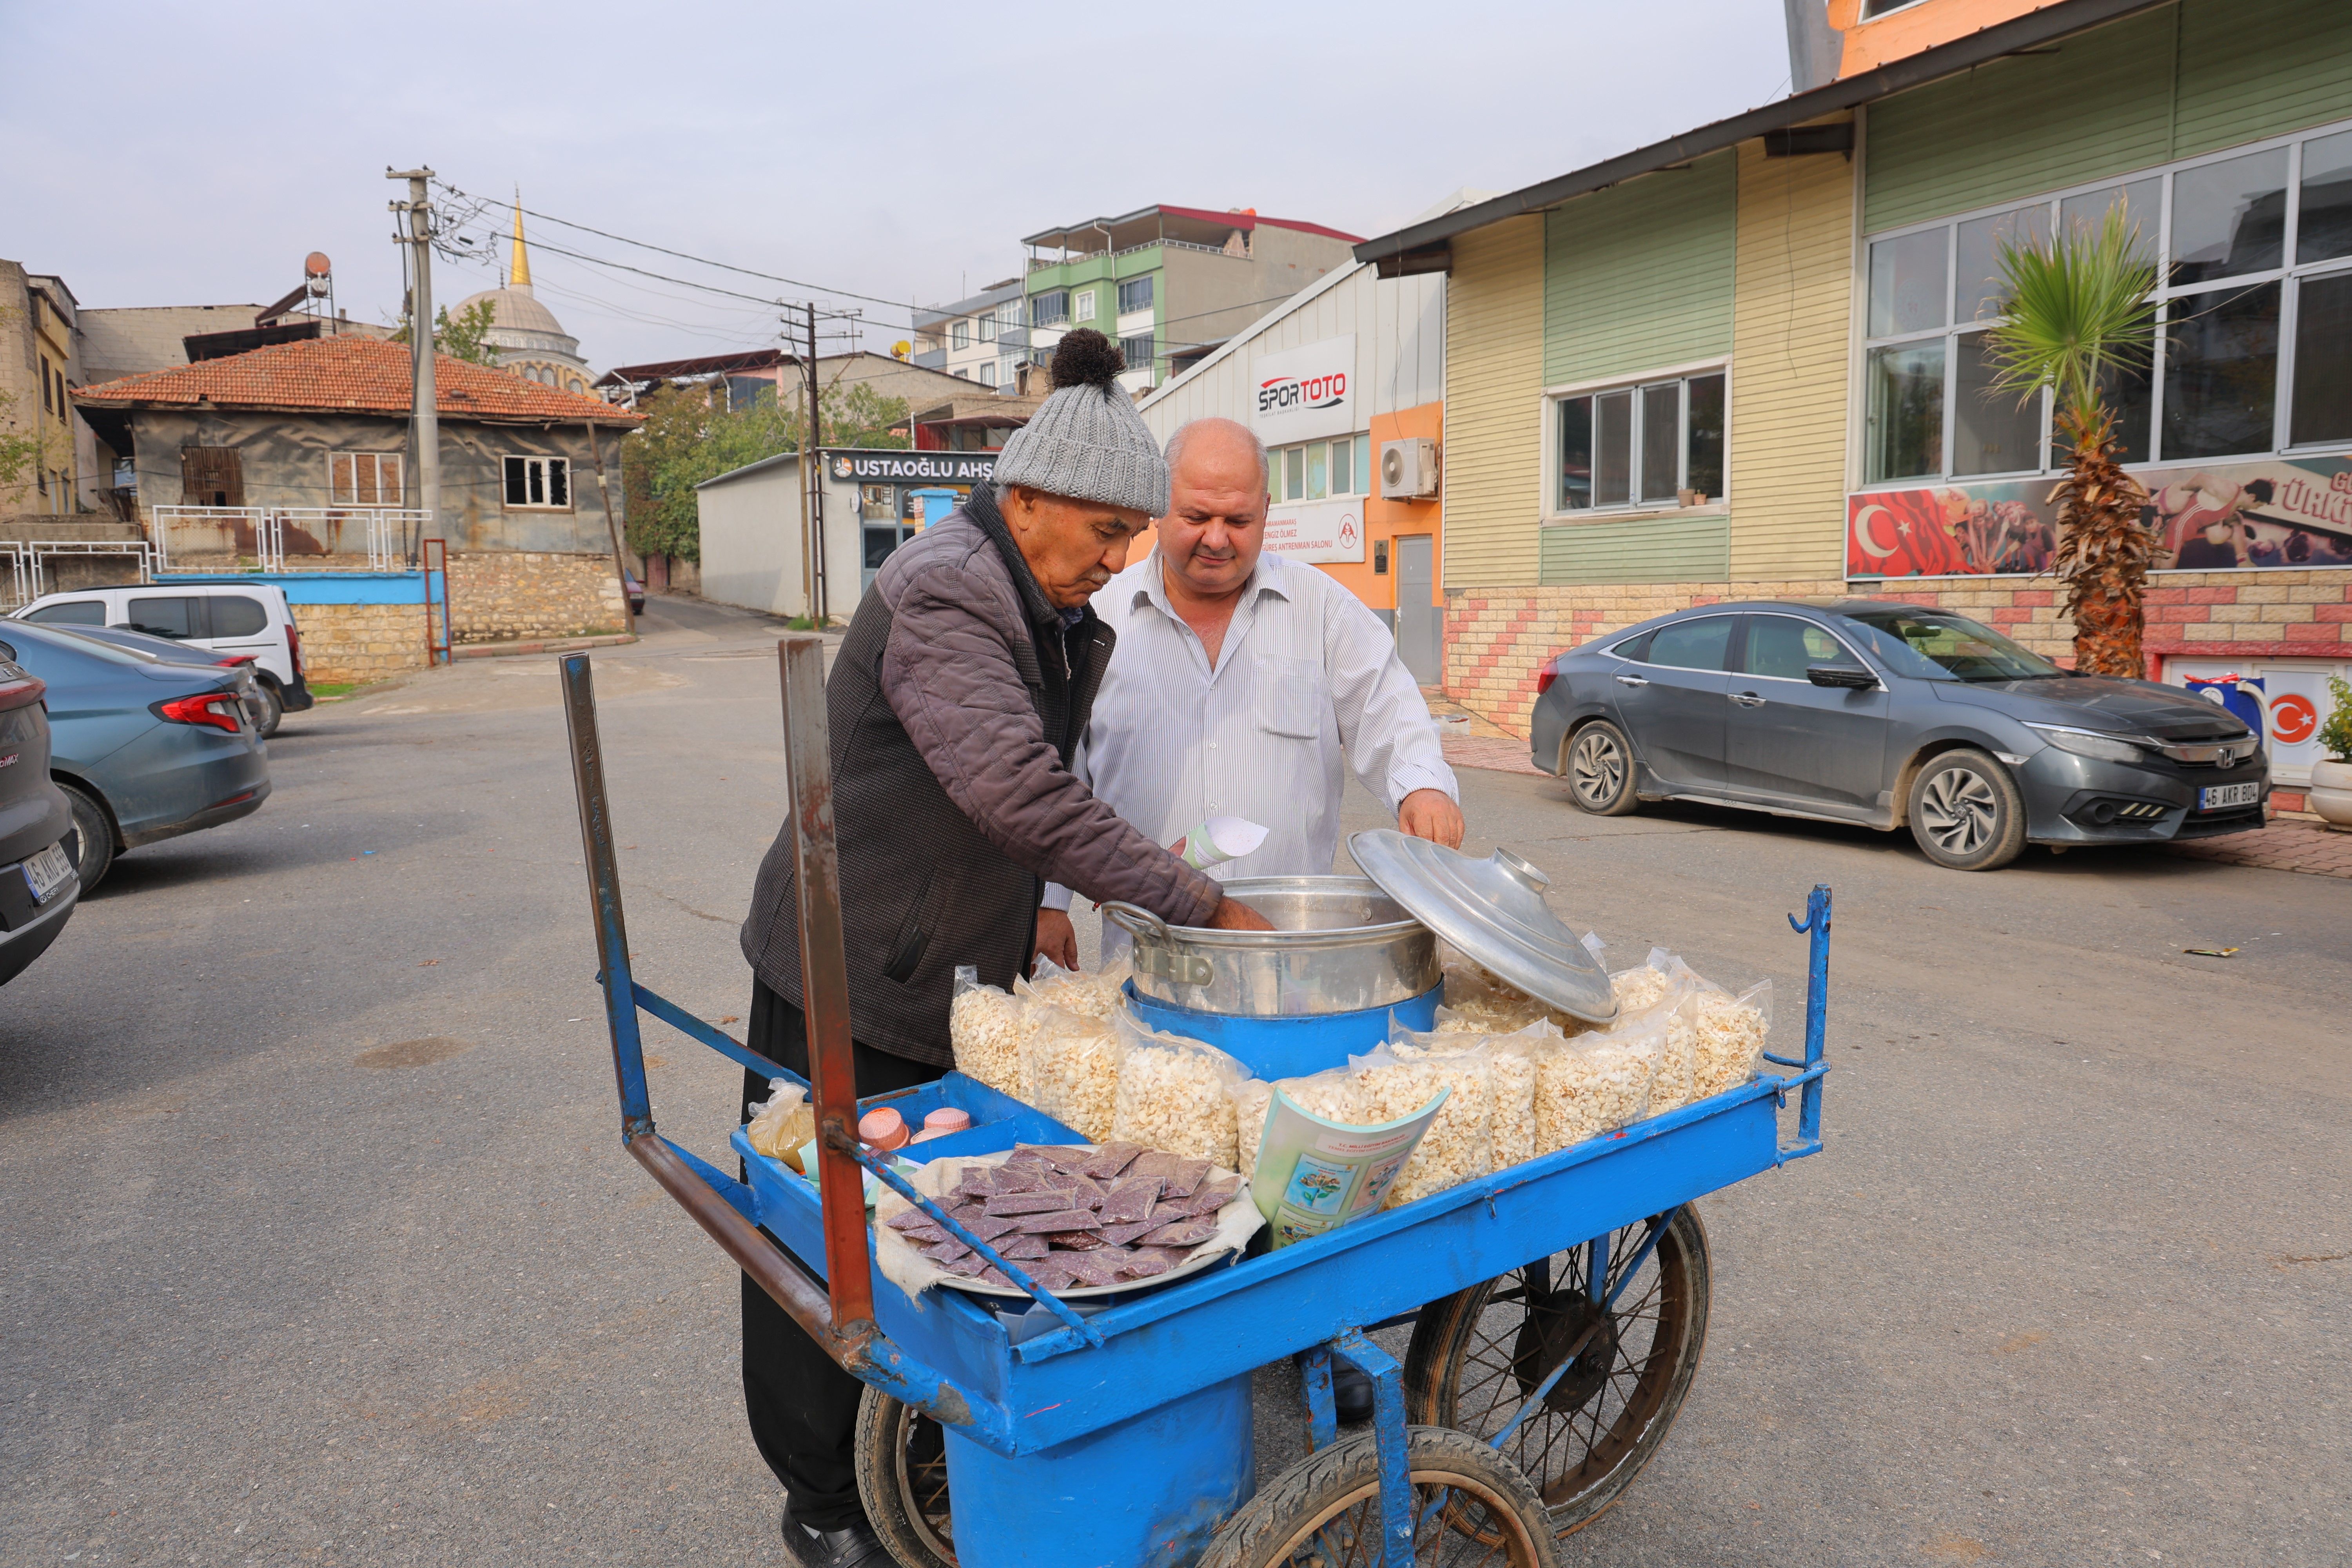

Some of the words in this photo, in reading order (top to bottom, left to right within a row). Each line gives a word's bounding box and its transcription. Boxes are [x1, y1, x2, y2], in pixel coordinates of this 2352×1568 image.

[855, 457, 953, 477] USTAOĞLU
[957, 462, 996, 481] AHŞ
[1265, 519, 1297, 527] HRAMANMARAŞ
[1280, 529, 1297, 537] ÖLMEZ
[1278, 541, 1310, 551] ANTRENMAN
[1311, 540, 1332, 548] SALONU
[2206, 788, 2218, 806] 46
[2222, 786, 2238, 804] AKR
[26, 862, 45, 889] 46
[39, 852, 60, 882] AKU
[46, 886, 59, 899] CHERY
